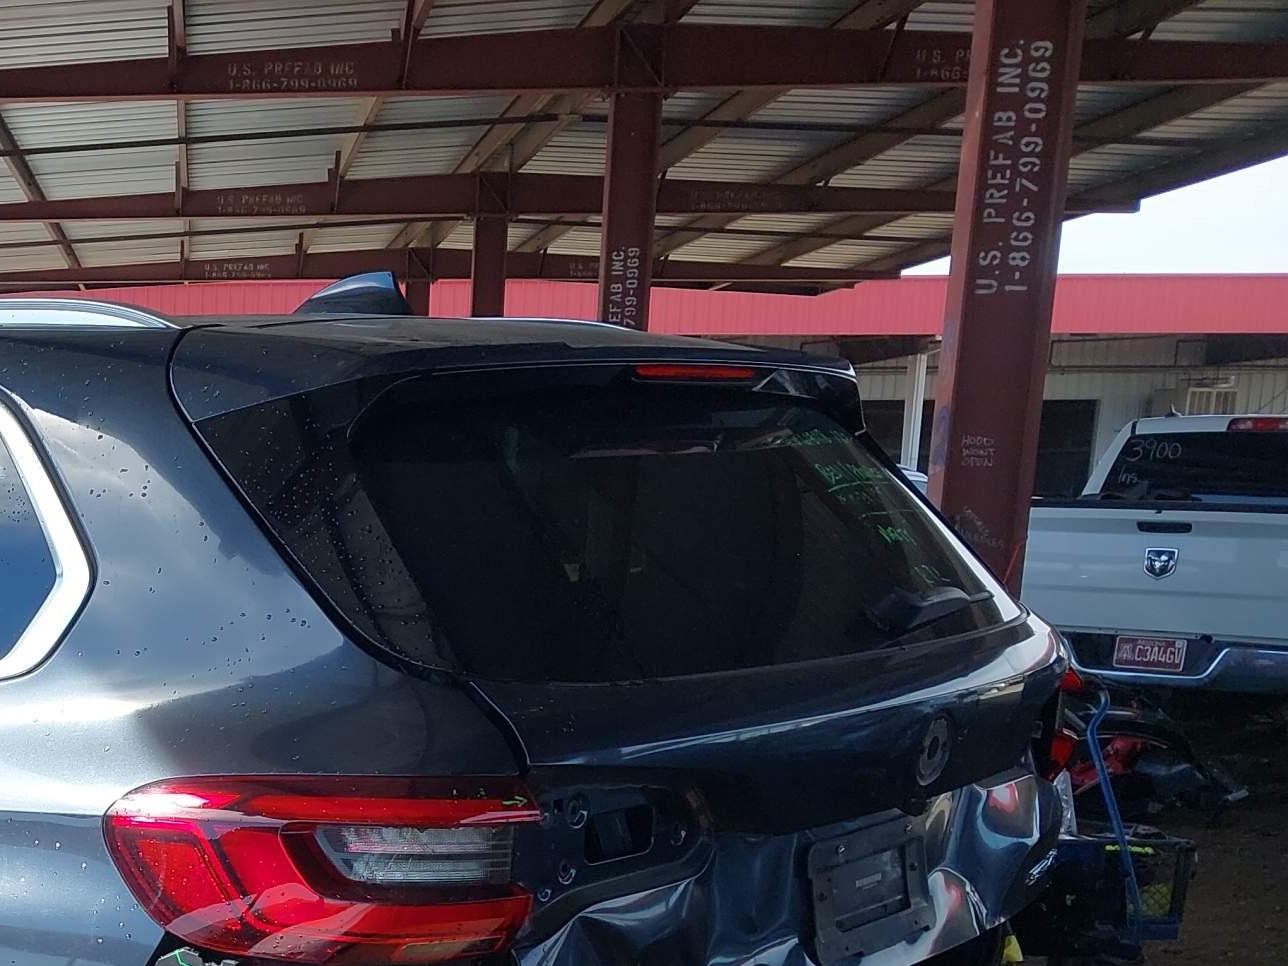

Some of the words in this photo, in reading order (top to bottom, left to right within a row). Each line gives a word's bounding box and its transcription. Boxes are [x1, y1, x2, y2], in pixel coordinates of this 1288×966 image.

[996, 39, 1024, 93] INC.
[983, 111, 1017, 223] PREFAB
[1004, 40, 1054, 292] 1-866-799-0969
[612, 246, 625, 275] INC.
[623, 247, 640, 326] 799-0969
[974, 241, 1003, 295] U.S.
[608, 283, 623, 323] EFAB
[1123, 438, 1182, 462] 3900
